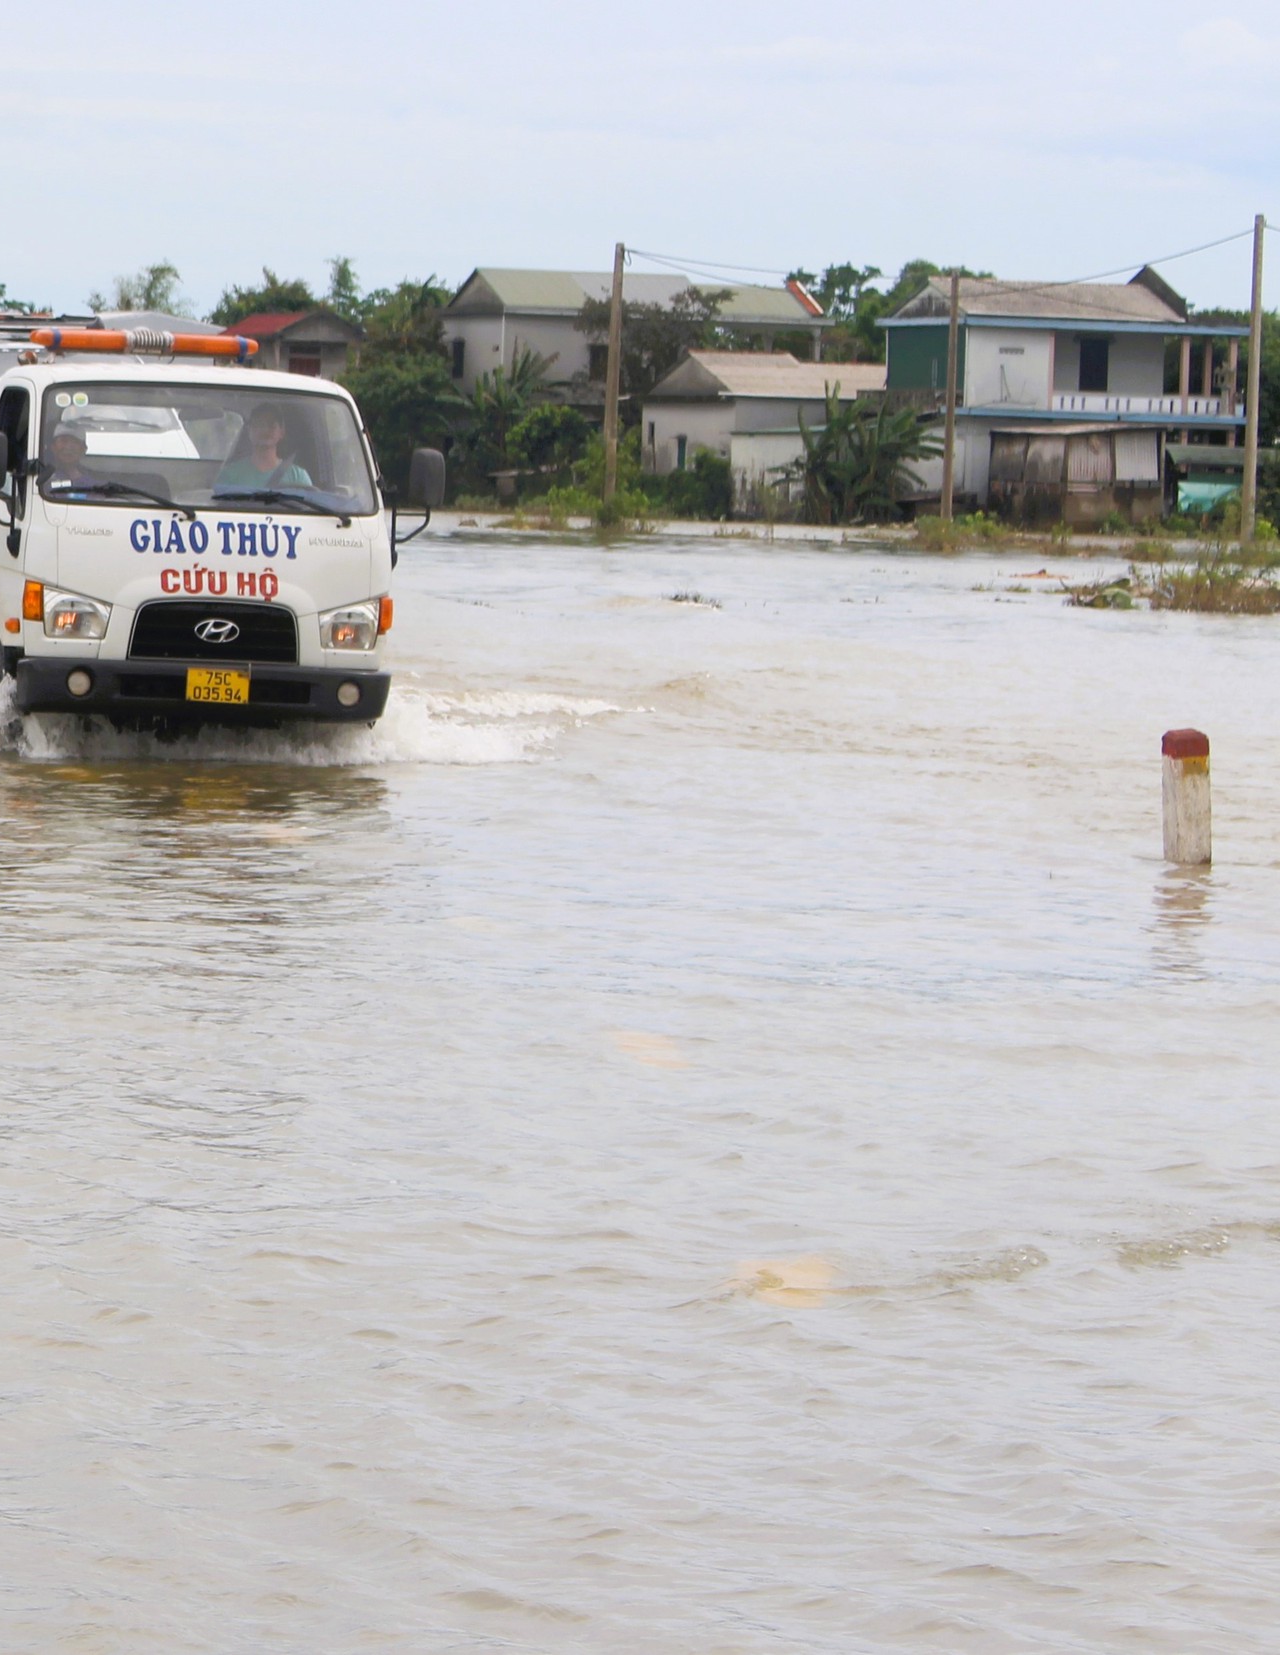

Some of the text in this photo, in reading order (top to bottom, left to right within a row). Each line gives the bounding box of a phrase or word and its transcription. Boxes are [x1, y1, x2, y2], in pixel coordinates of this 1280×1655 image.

[217, 517, 302, 560] THỦY
[160, 563, 279, 602] CỨU HỘ
[206, 671, 231, 686] 75C
[193, 686, 242, 703] 035.94
